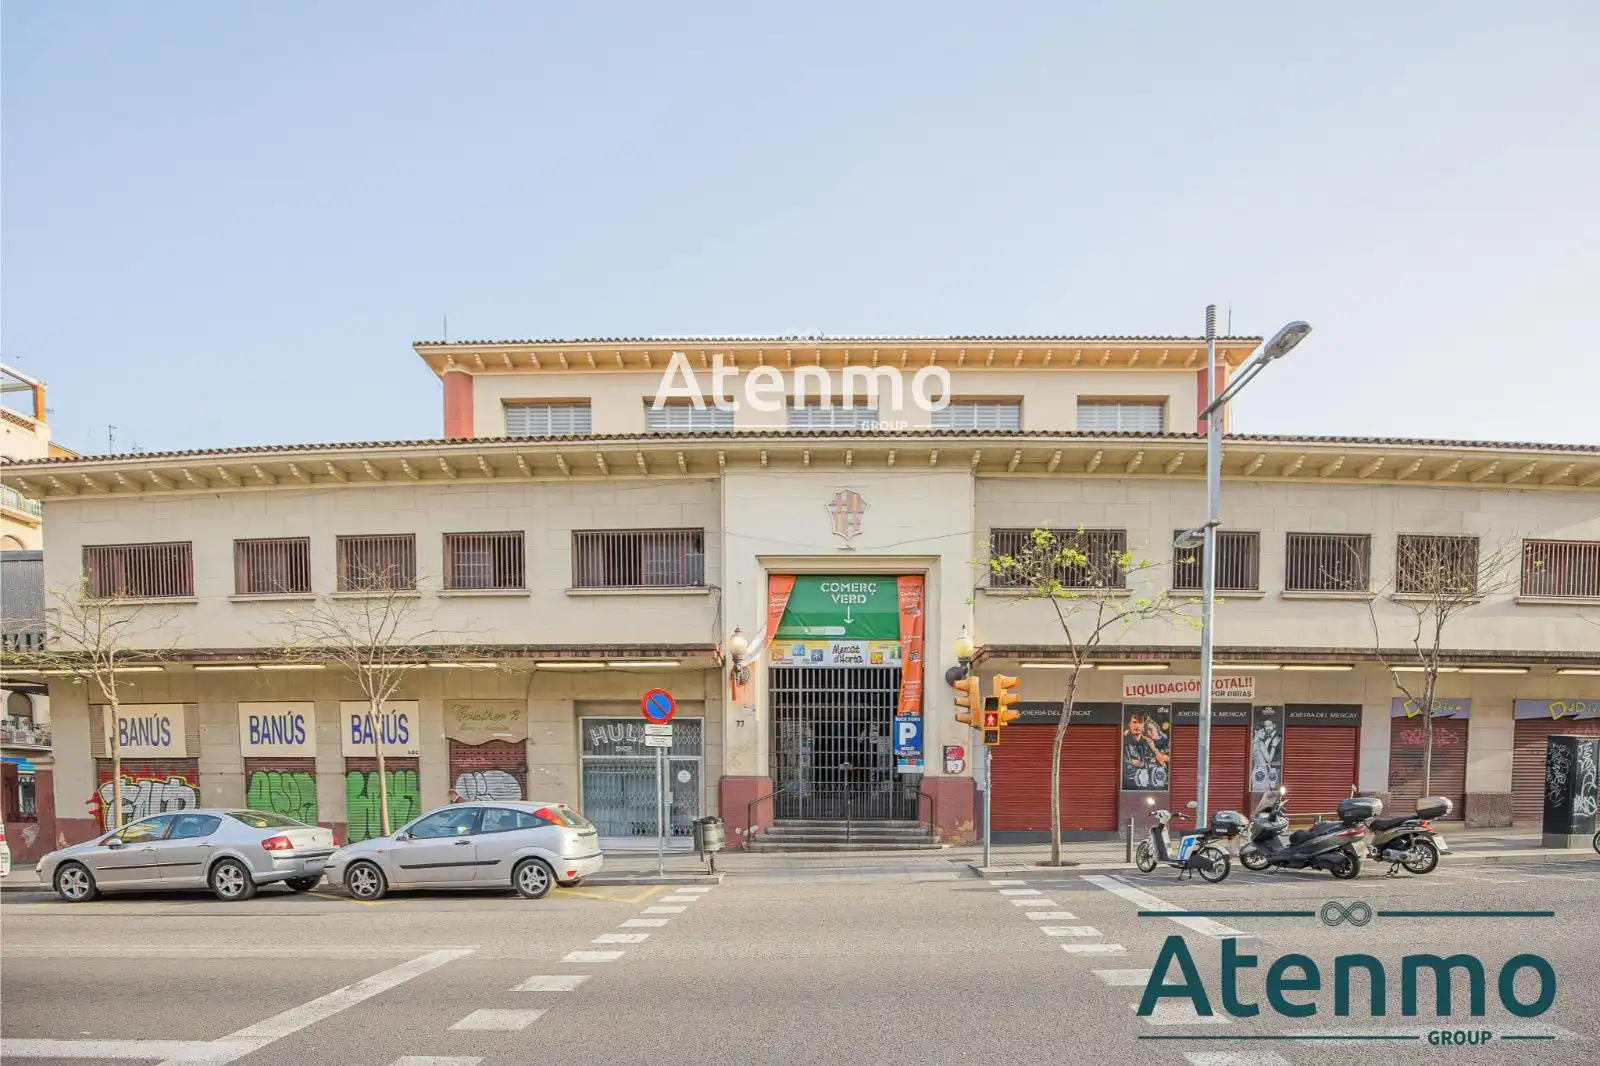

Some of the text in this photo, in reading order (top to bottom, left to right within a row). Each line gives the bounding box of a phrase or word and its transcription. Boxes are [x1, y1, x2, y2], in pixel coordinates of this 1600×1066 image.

[821, 582, 877, 595] COMERÇ
[831, 594, 867, 604] VERD
[832, 643, 861, 655] Mercat
[1125, 676, 1253, 697] LIQUIDACIÓN TOTAL!!
[1210, 690, 1253, 698] POR OBRAS
[351, 709, 409, 744] BANÚS
[1330, 712, 1358, 720] MERCAT
[118, 713, 171, 747] BANÚS
[249, 711, 306, 745] BANÚS
[590, 723, 645, 746] HUL
[899, 722, 917, 745] P
